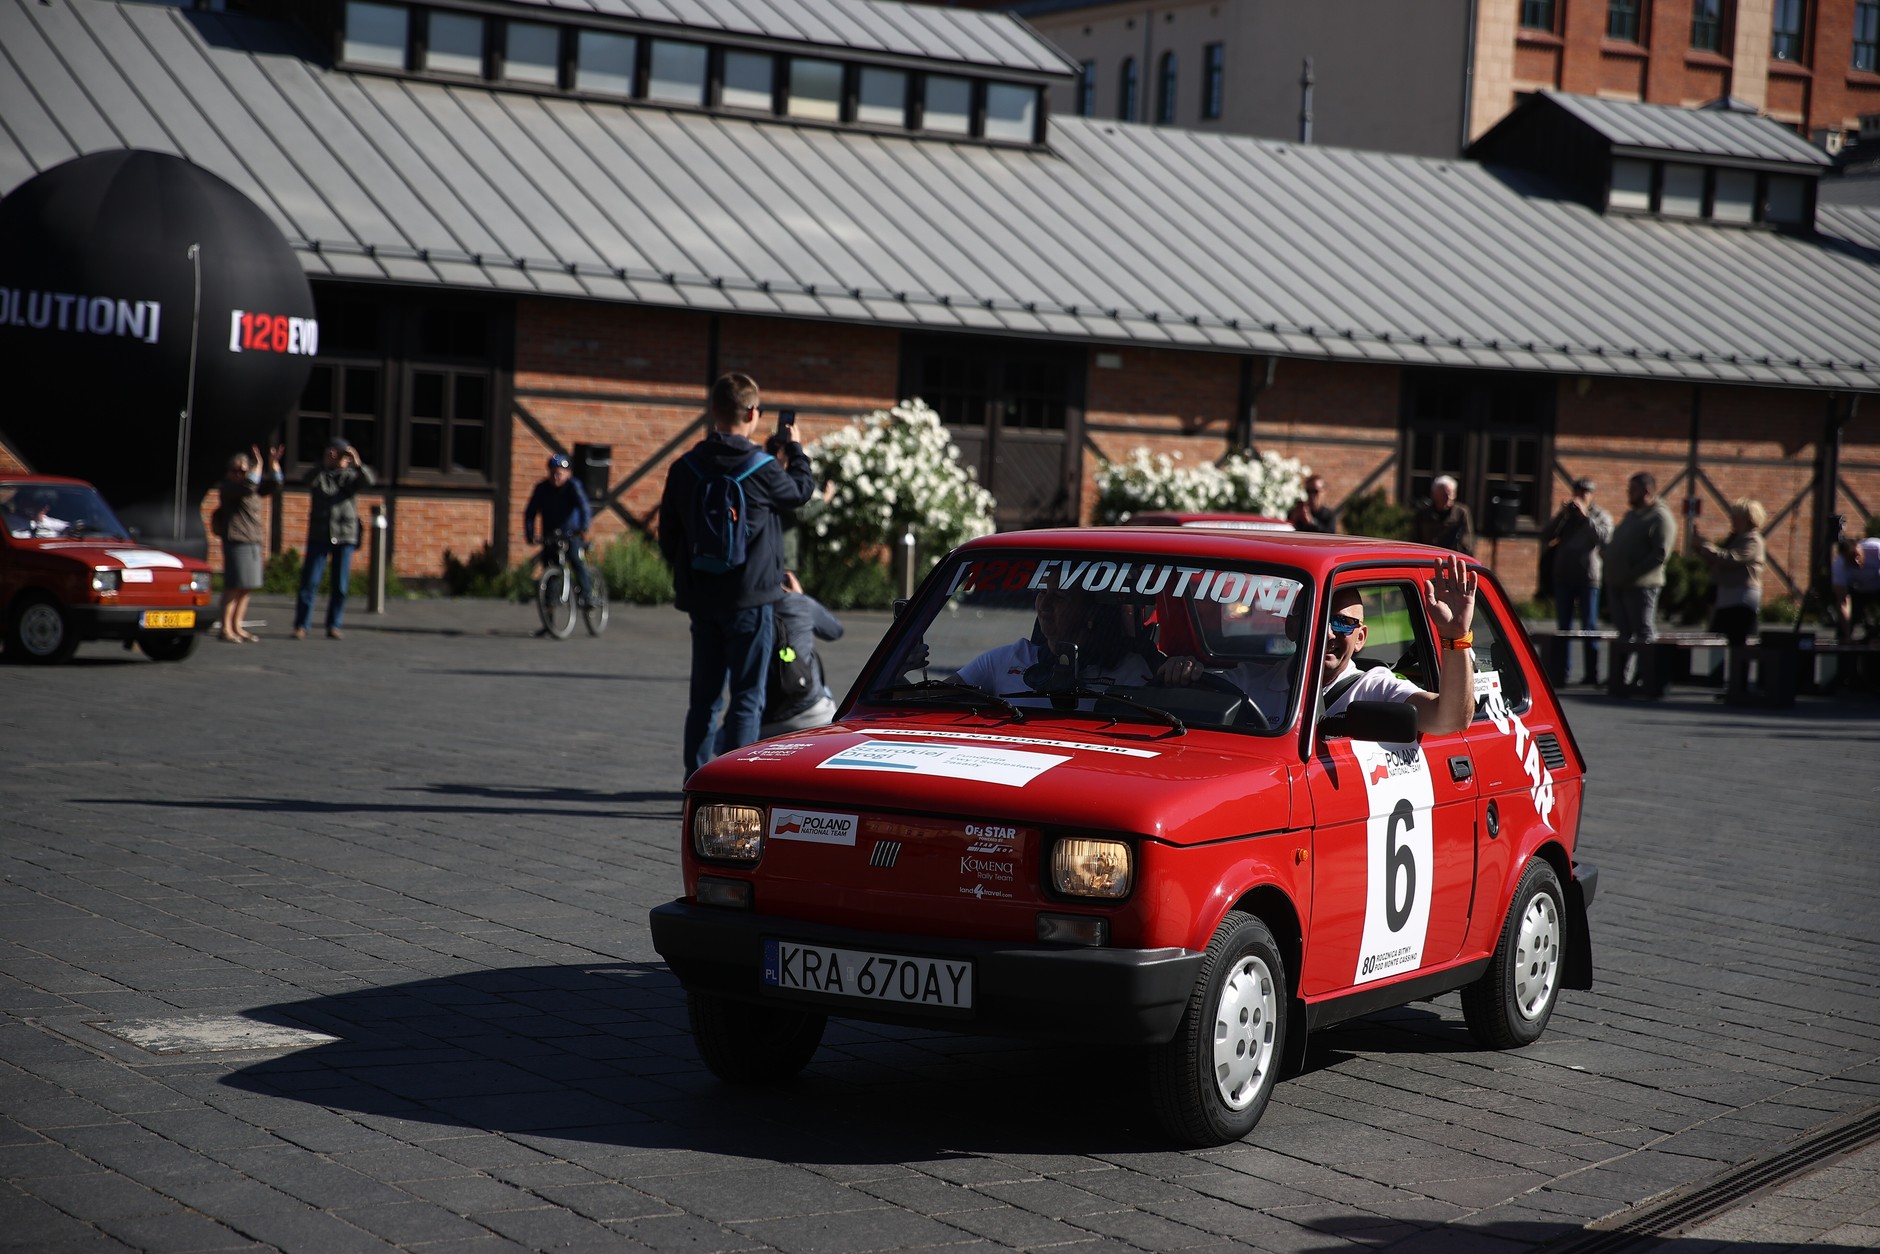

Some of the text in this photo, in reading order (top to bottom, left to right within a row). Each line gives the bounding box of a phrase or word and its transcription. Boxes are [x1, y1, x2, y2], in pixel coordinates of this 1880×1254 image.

[966, 735, 1064, 746] NATIONAL
[1073, 744, 1129, 753] TEAM
[839, 751, 896, 760] Drogi
[851, 746, 945, 758] Szerokiej
[1385, 748, 1420, 768] POLAND
[803, 817, 851, 831] POLAND
[801, 828, 829, 836] NATIONAL
[1385, 798, 1417, 933] 6
[977, 871, 1013, 882] Rally Team
[1361, 955, 1376, 976] 80
[765, 969, 778, 981] PL
[781, 947, 967, 1005] KRA 670AY
